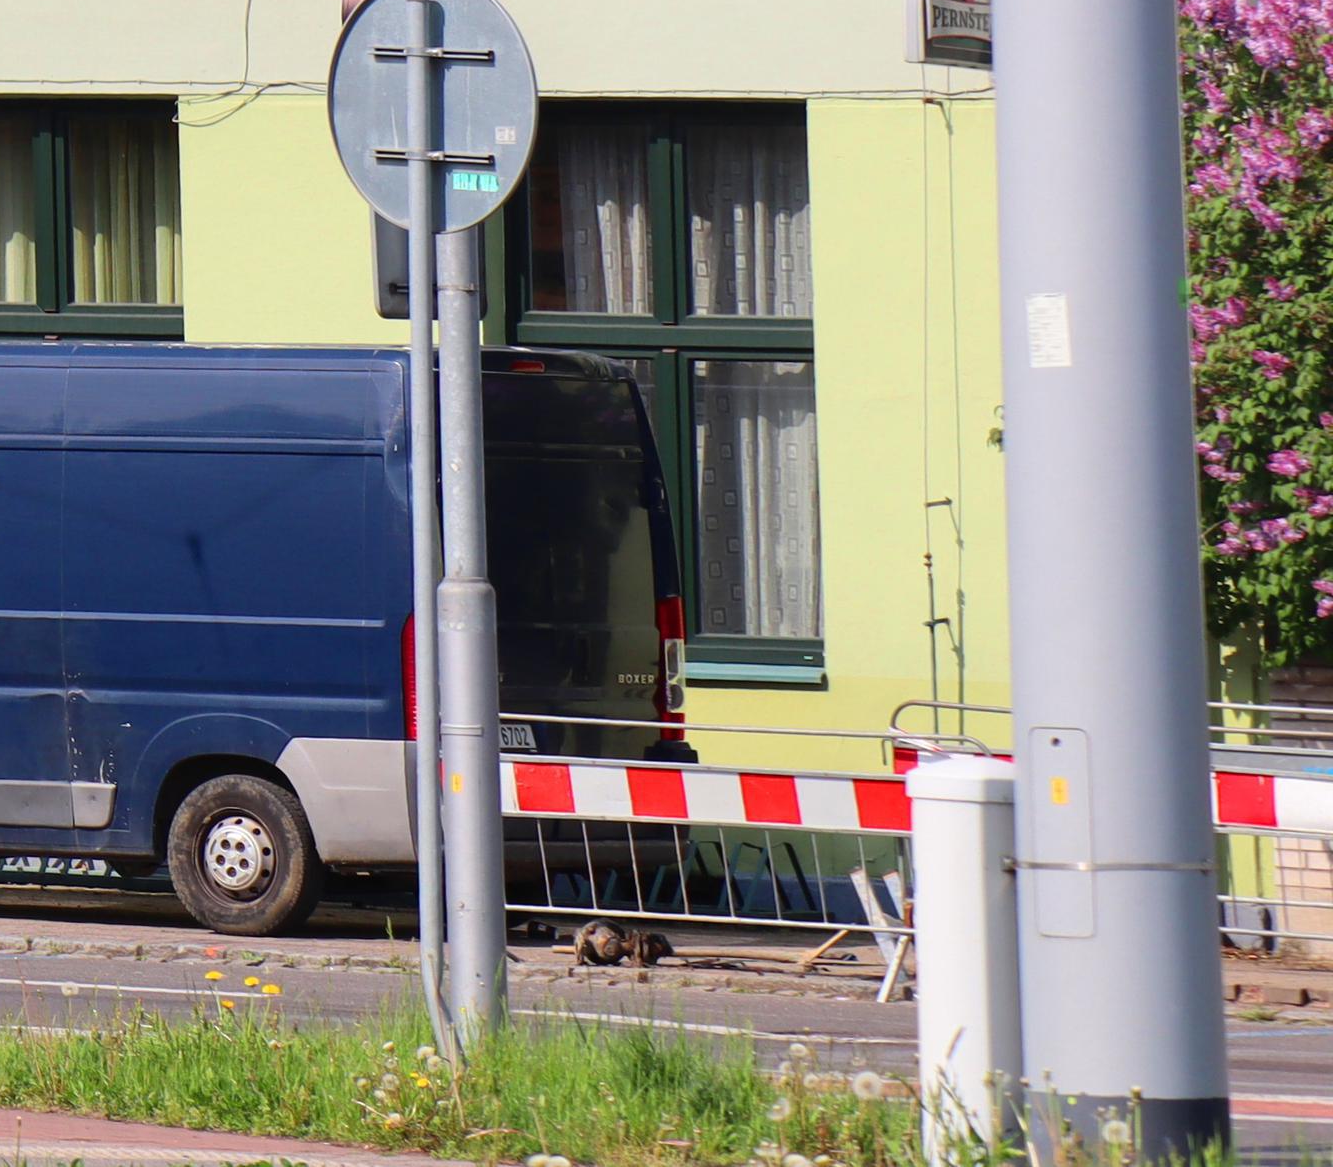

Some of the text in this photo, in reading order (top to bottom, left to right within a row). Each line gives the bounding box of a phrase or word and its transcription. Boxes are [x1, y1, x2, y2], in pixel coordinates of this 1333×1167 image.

[932, 5, 990, 33] PERNŠTE
[618, 674, 655, 684] BOXER
[500, 726, 530, 746] 6702
